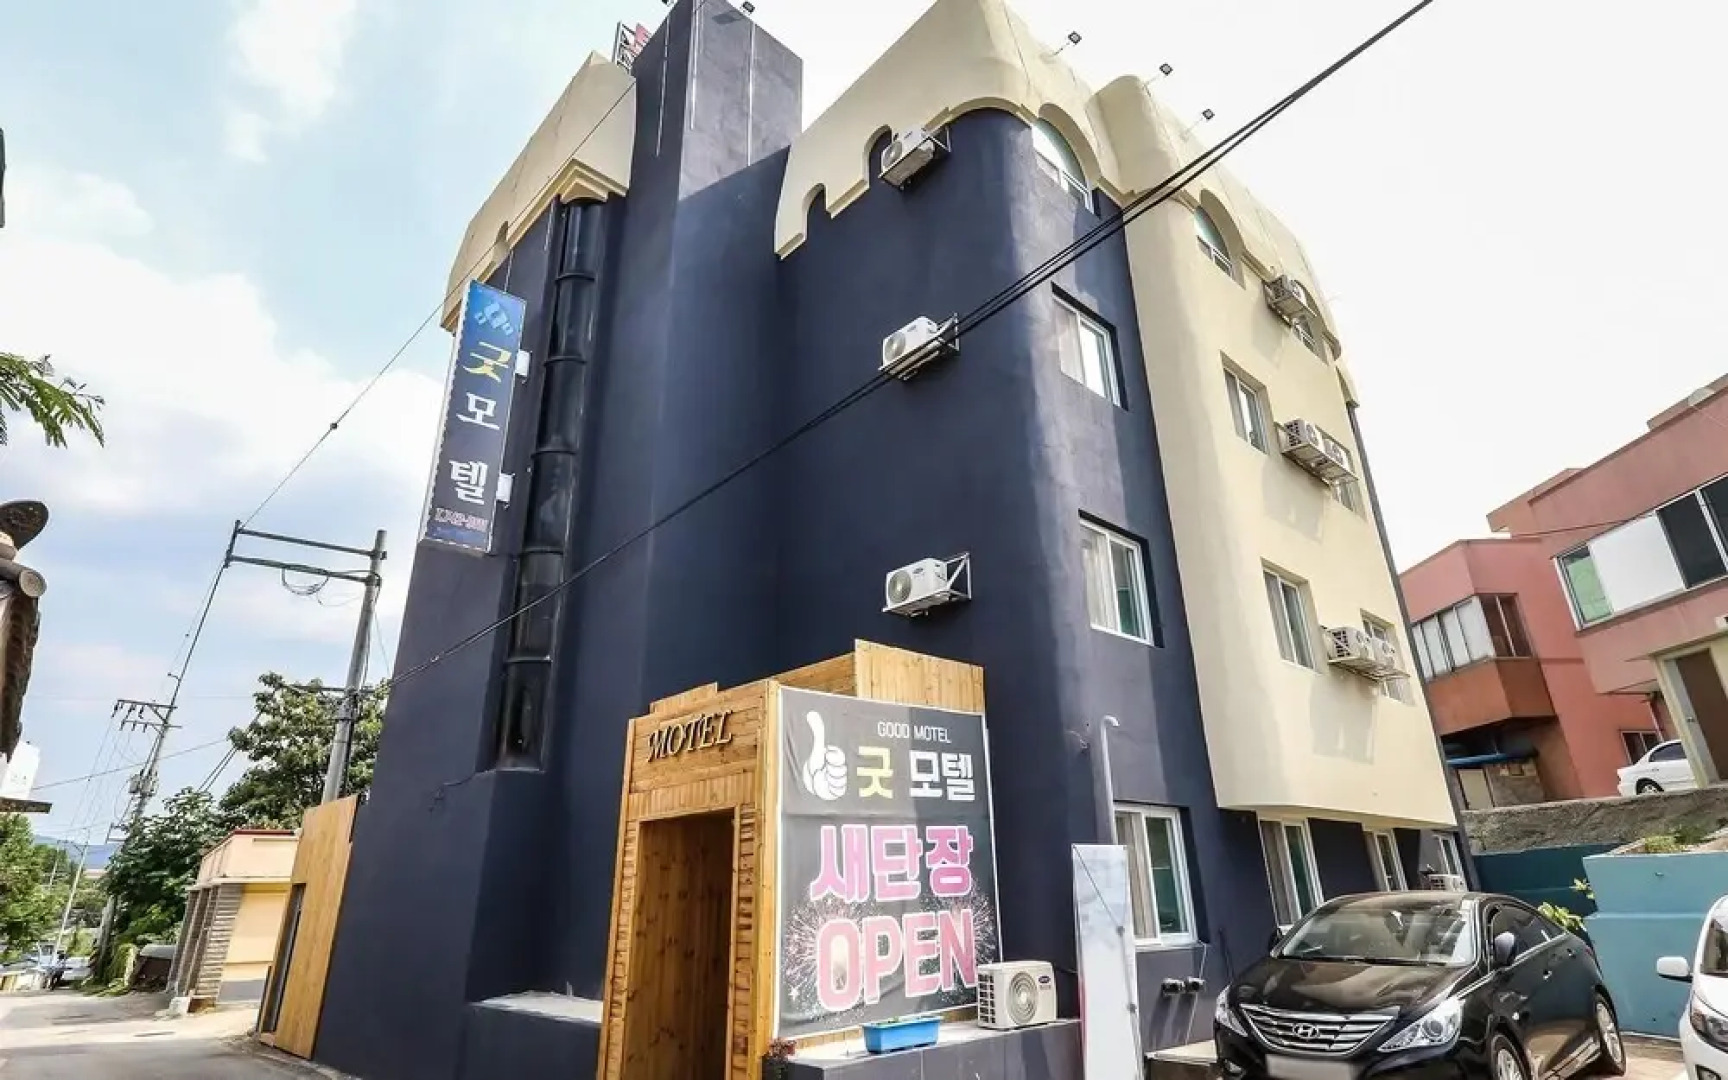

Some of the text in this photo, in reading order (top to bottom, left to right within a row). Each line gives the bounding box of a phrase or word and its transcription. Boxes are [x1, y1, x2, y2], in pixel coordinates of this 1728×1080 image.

[646, 709, 733, 762] MOTEL
[877, 721, 952, 744] GOOD MOTEL
[857, 746, 976, 801] 굿 모텔
[810, 824, 974, 903] 새단장
[817, 908, 979, 1012] OPEN
